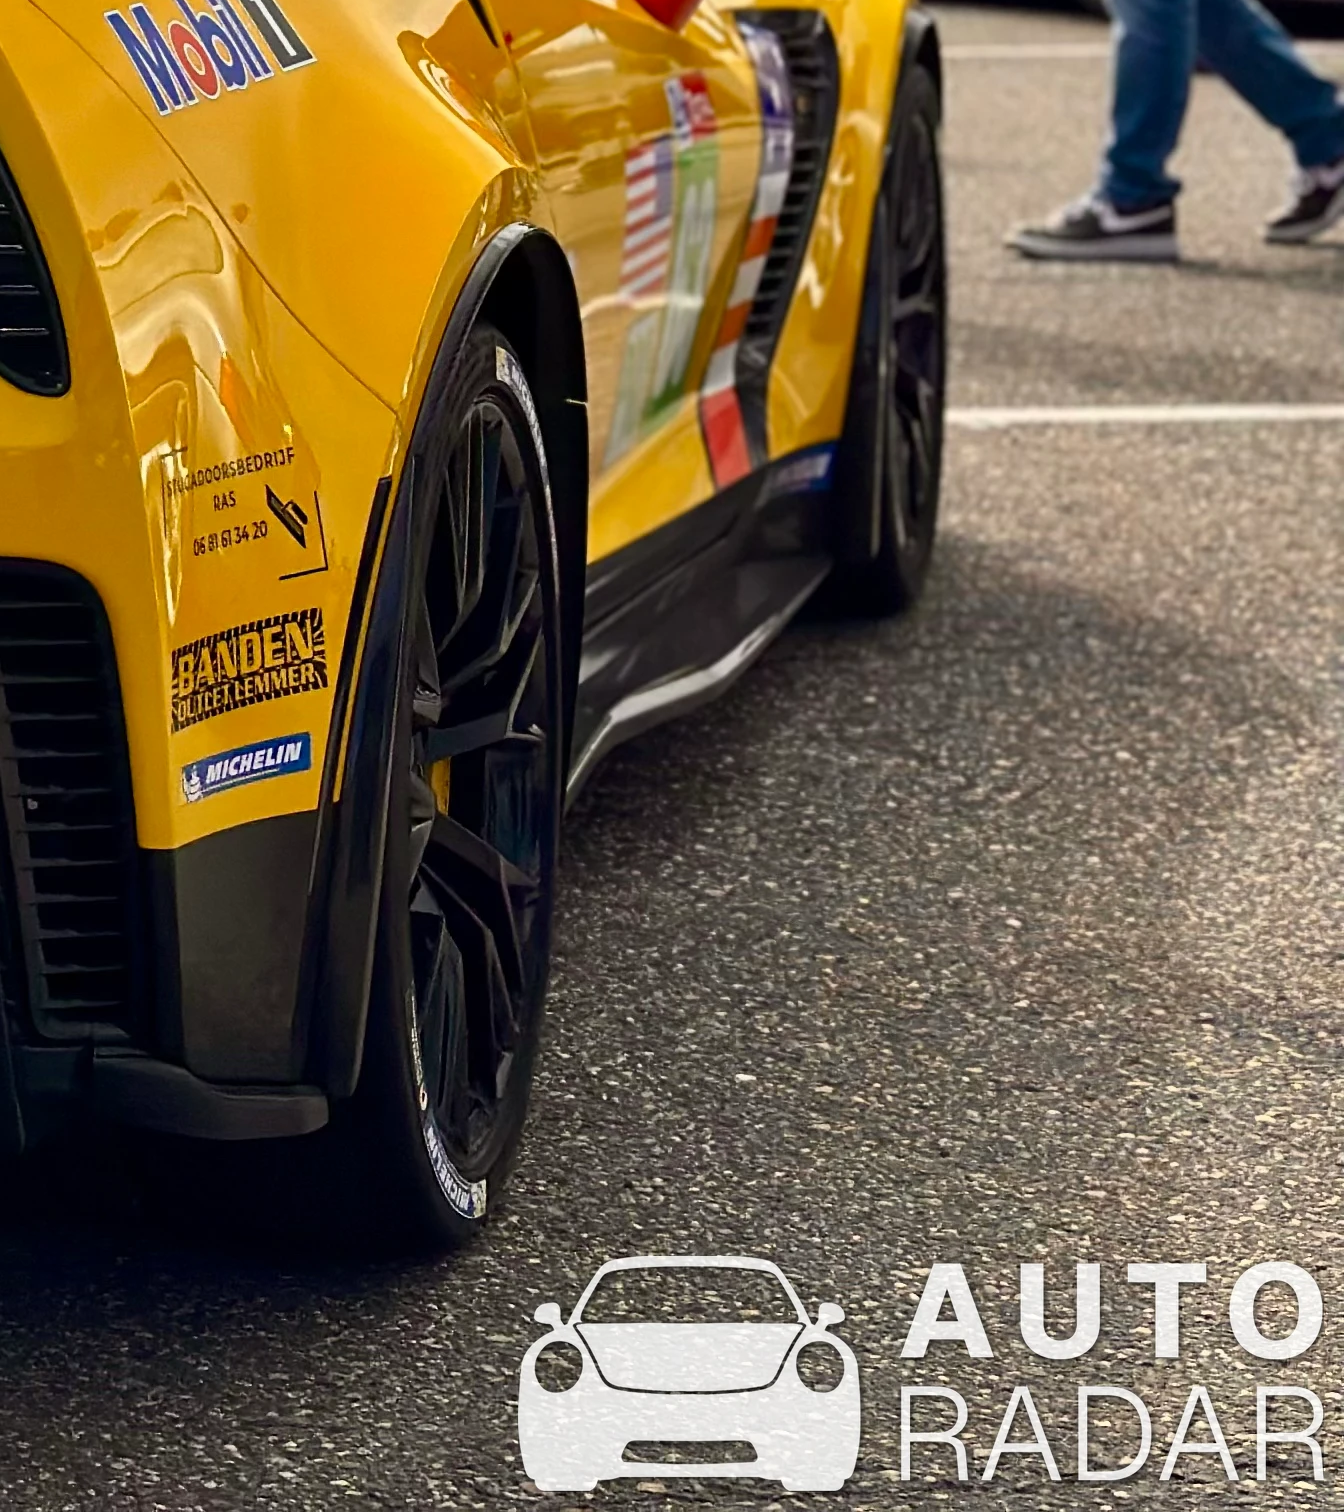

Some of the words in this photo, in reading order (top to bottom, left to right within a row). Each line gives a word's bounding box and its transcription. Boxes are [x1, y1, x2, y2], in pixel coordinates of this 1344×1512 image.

[213, 491, 237, 511] RAS
[193, 536, 206, 556] 06
[221, 529, 232, 548] 61
[233, 525, 250, 544] 34
[252, 520, 268, 540] 20
[178, 618, 314, 697] BANDEN
[177, 684, 231, 721] OUTLET
[235, 662, 316, 700] LEMMER
[206, 740, 303, 784] MICHELIN
